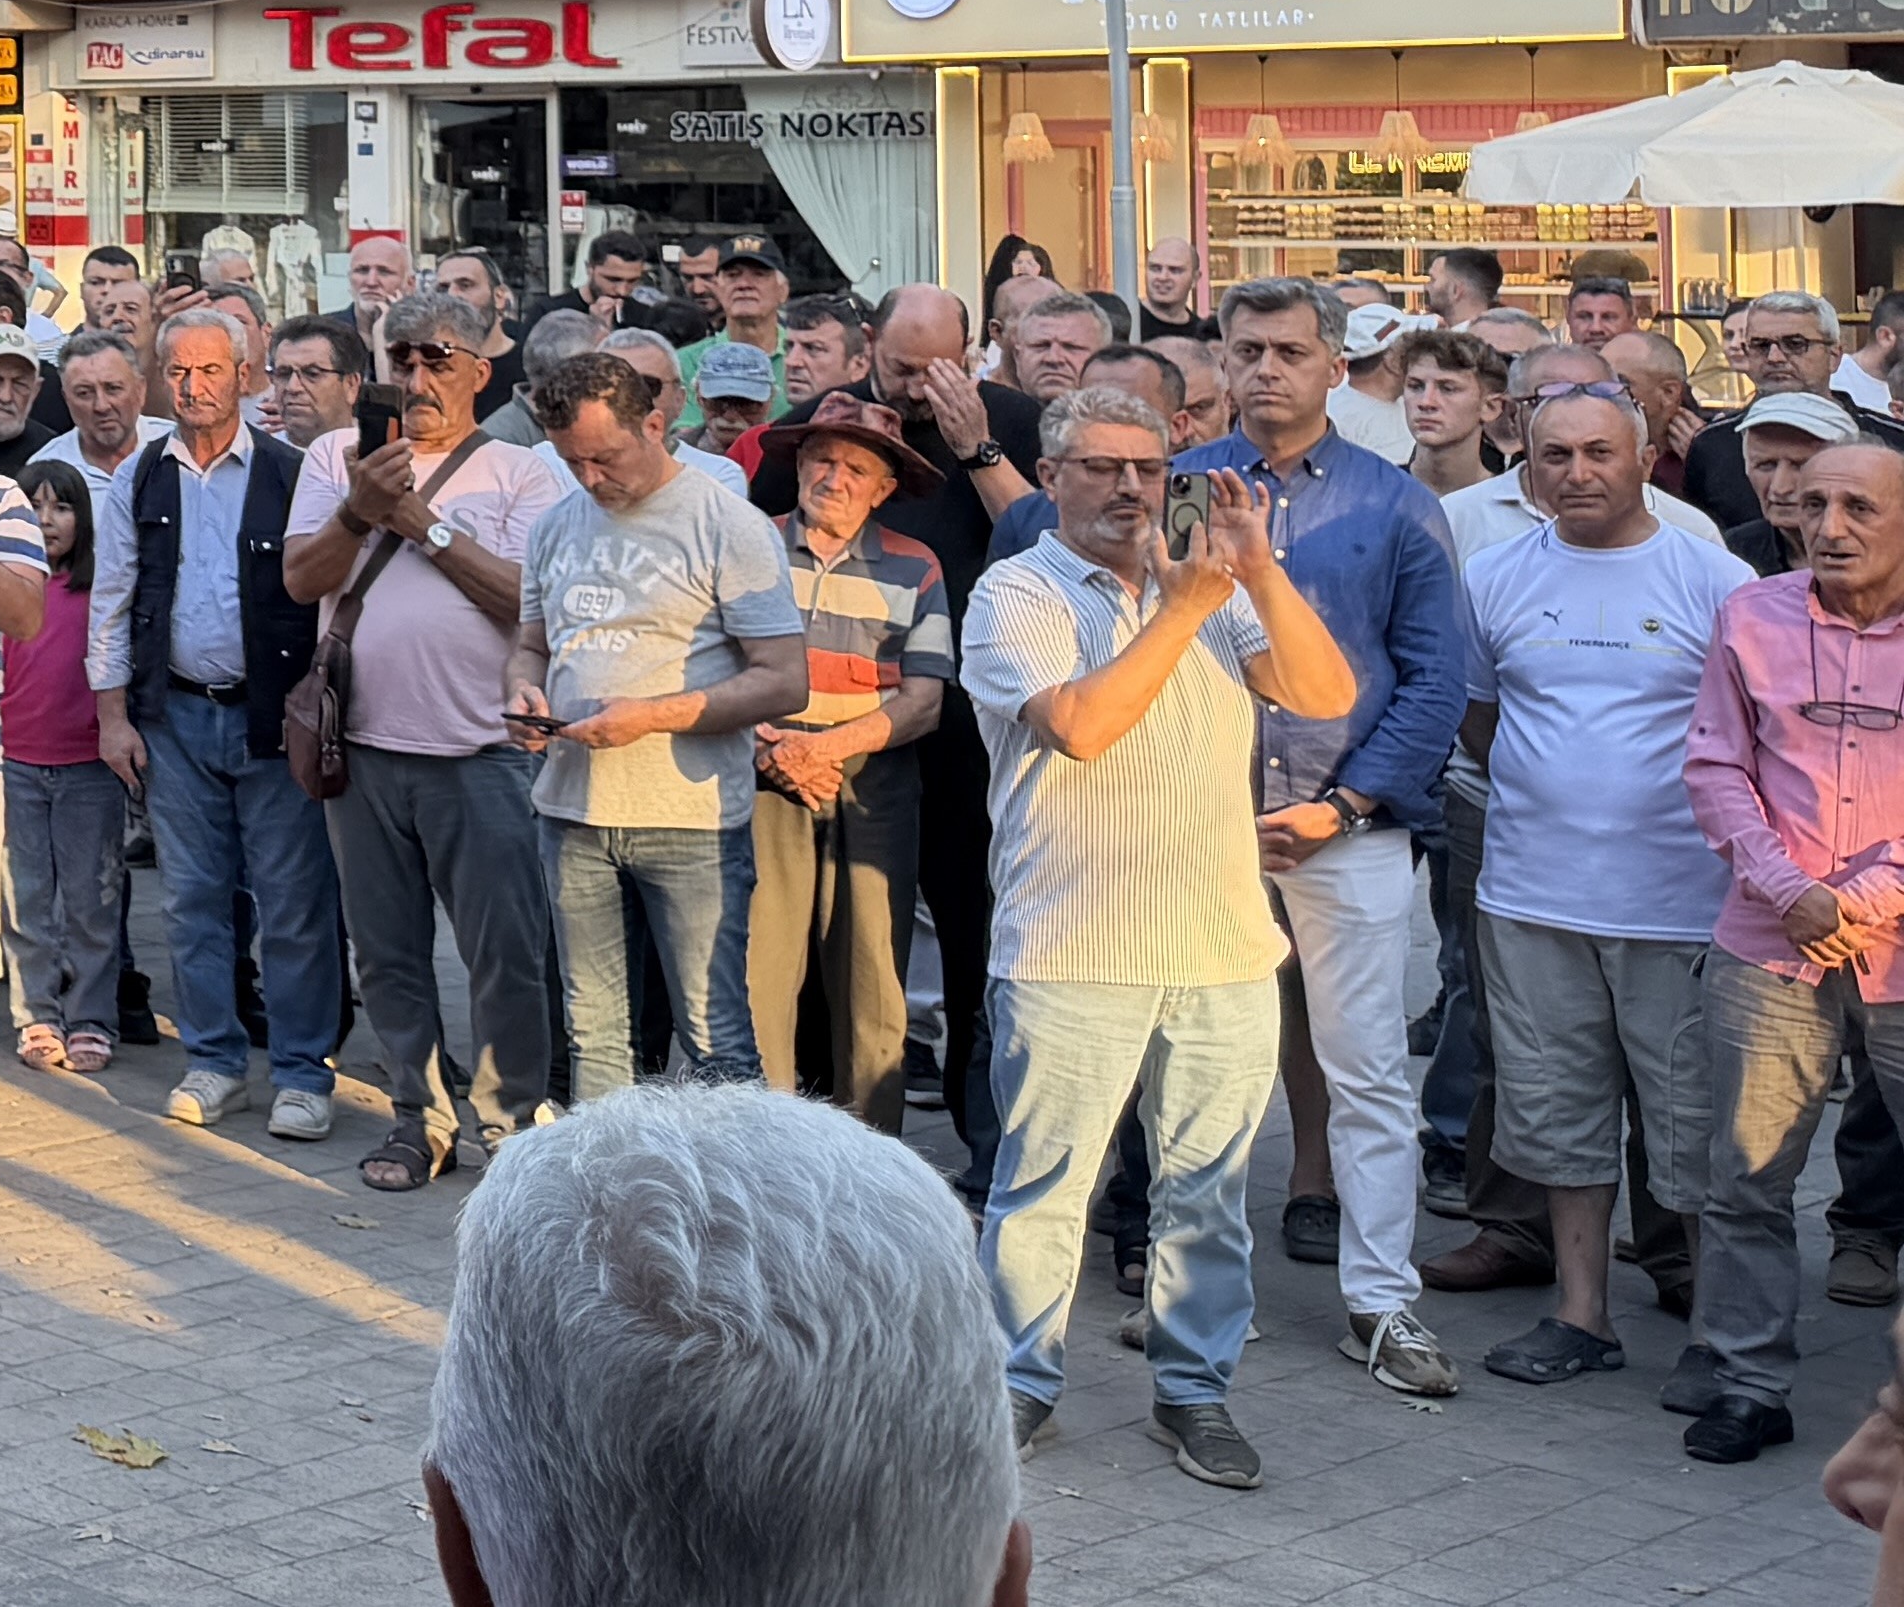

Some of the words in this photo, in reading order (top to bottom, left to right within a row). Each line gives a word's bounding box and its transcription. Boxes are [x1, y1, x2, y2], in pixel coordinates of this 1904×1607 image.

[1198, 8, 1305, 29] TATLILAR
[263, 1, 618, 71] Tefal
[91, 44, 122, 67] TAC
[670, 111, 763, 148] SATIŞ
